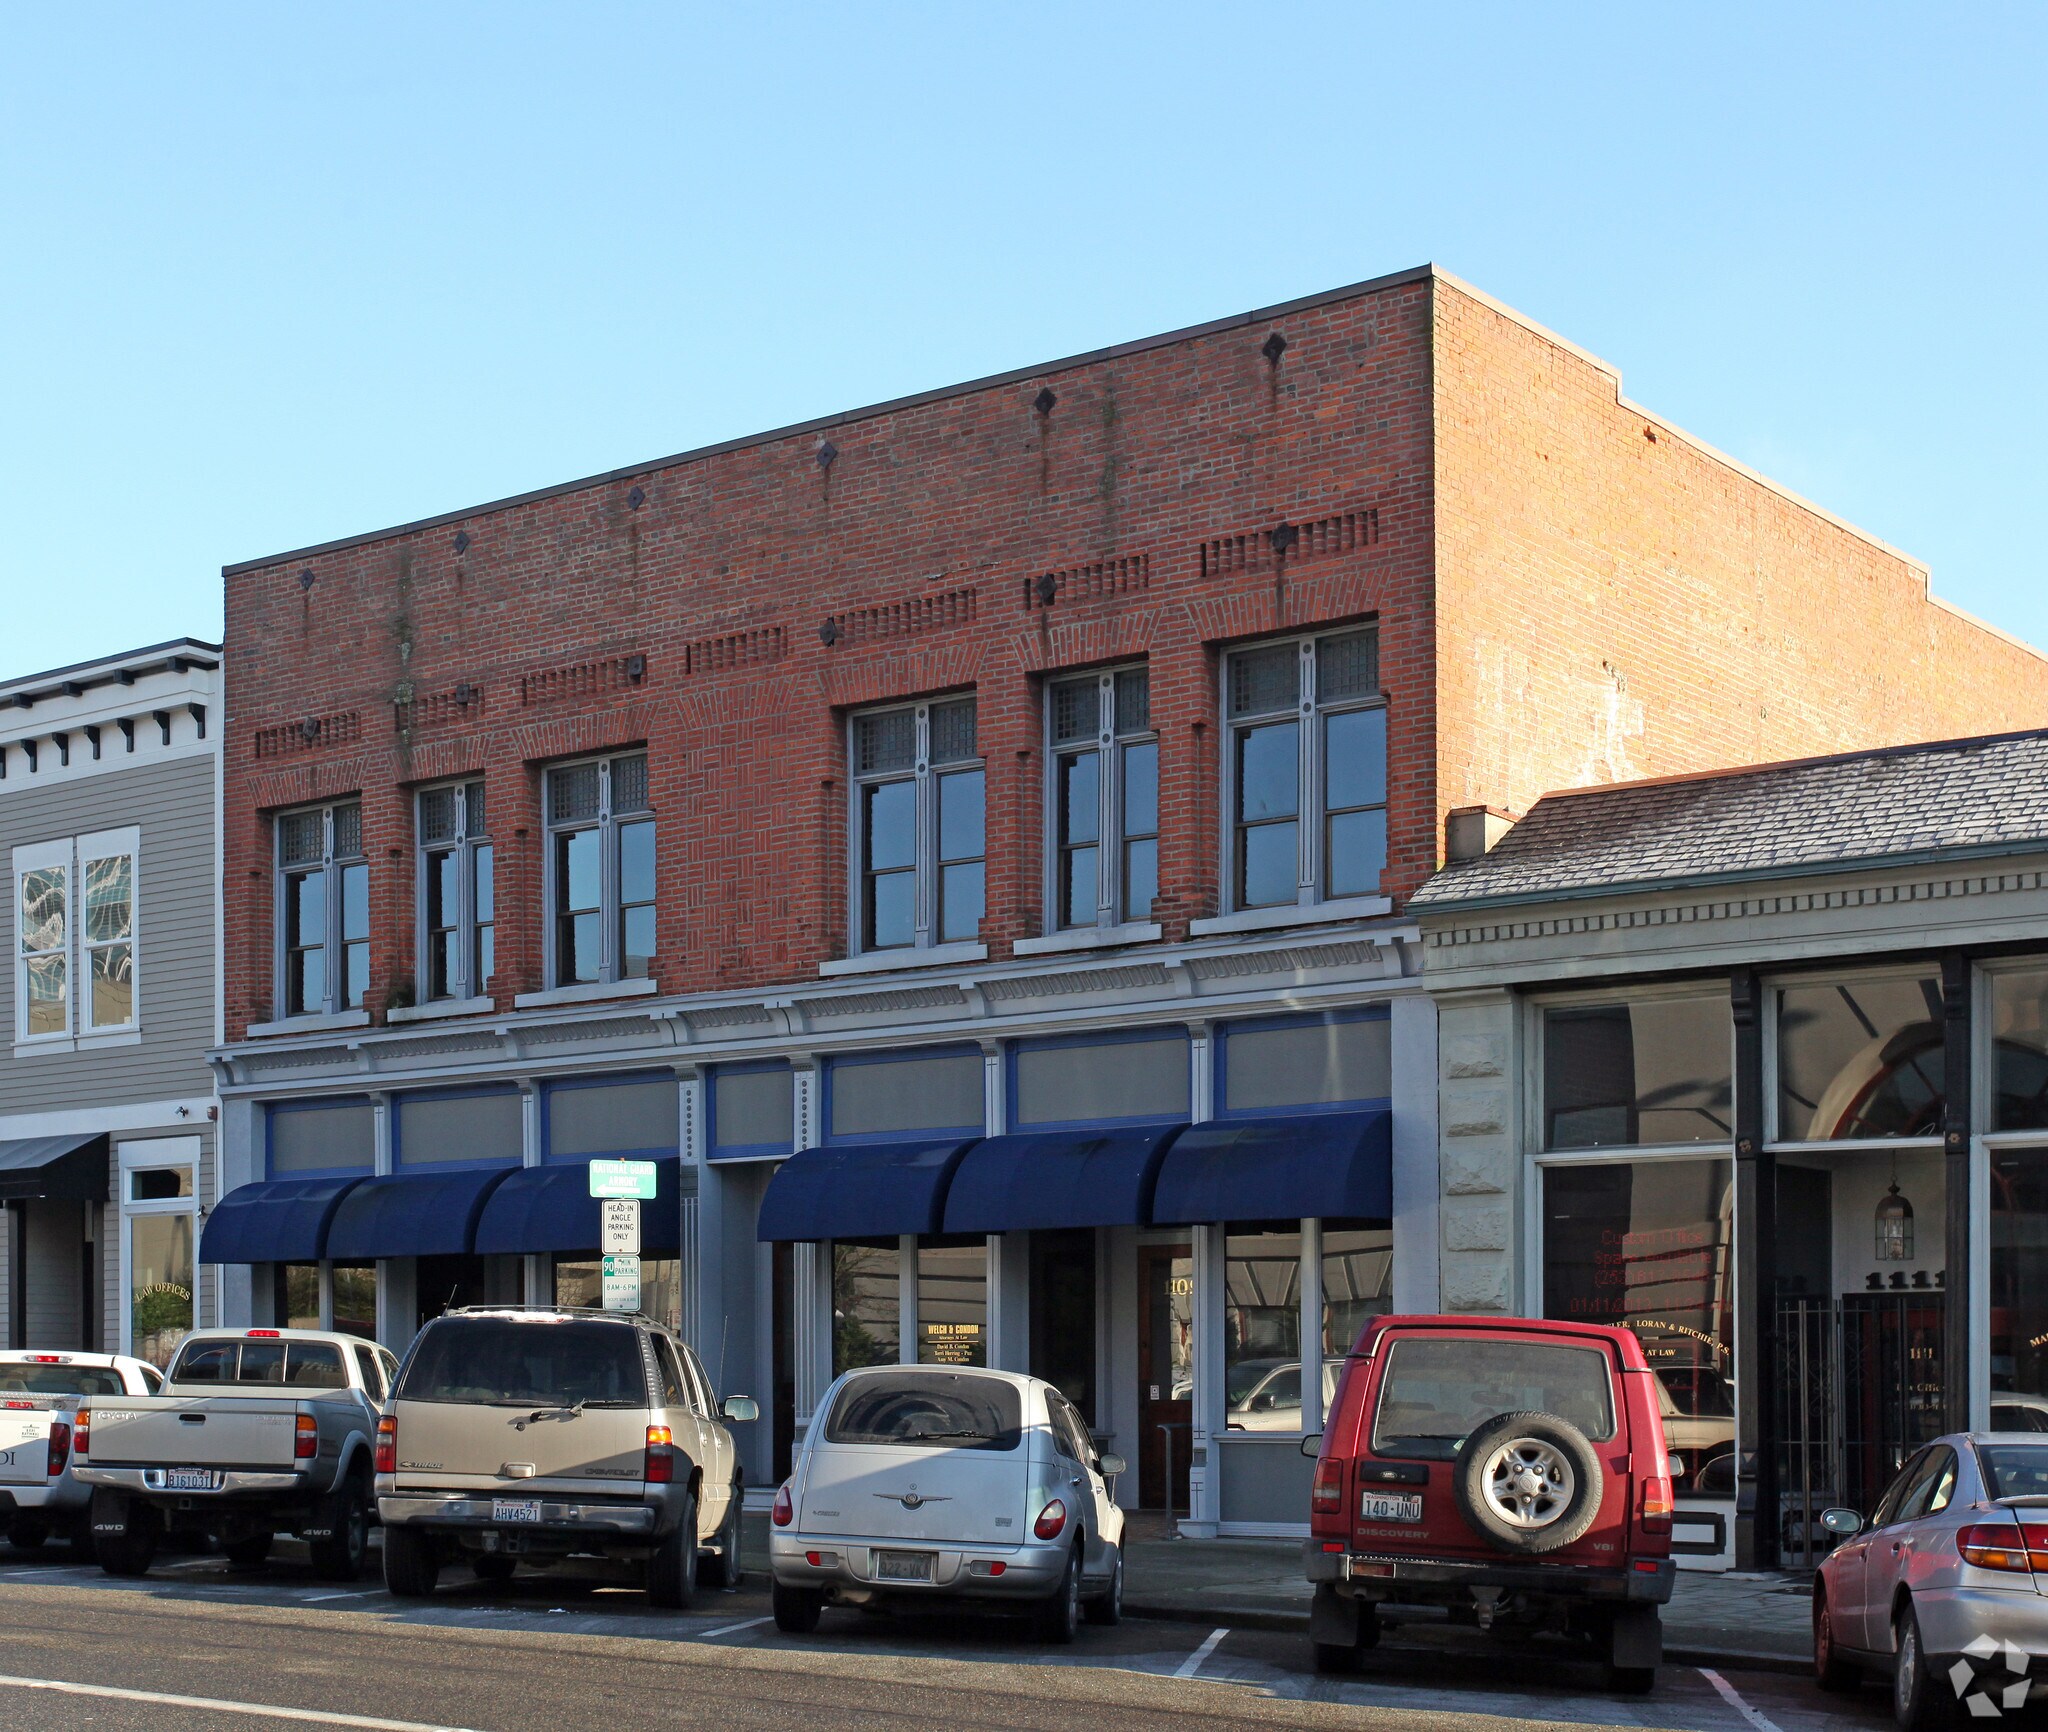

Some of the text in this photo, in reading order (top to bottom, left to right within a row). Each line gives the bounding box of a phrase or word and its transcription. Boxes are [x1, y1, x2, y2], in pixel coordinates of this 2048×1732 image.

[592, 1163, 654, 1175] NATIONAL GUARD
[608, 1176, 638, 1187] ARMORY
[608, 1204, 634, 1212] HEAD-IN
[610, 1214, 632, 1222] ANGLE
[607, 1223, 635, 1231] PARKING
[612, 1232, 629, 1240] ONLY
[604, 1261, 614, 1272] 90
[615, 1267, 638, 1275] PARKING
[136, 1282, 191, 1302] LAW OFFICES
[928, 1324, 947, 1335] WELCH
[955, 1324, 979, 1335] CONDON
[1636, 1319, 1666, 1329] LORAN
[1668, 1323, 1676, 1331] &
[96, 1411, 137, 1420] TOYOTA
[495, 1507, 538, 1521] AHV4521
[1357, 1527, 1430, 1539] DISCOVERY
